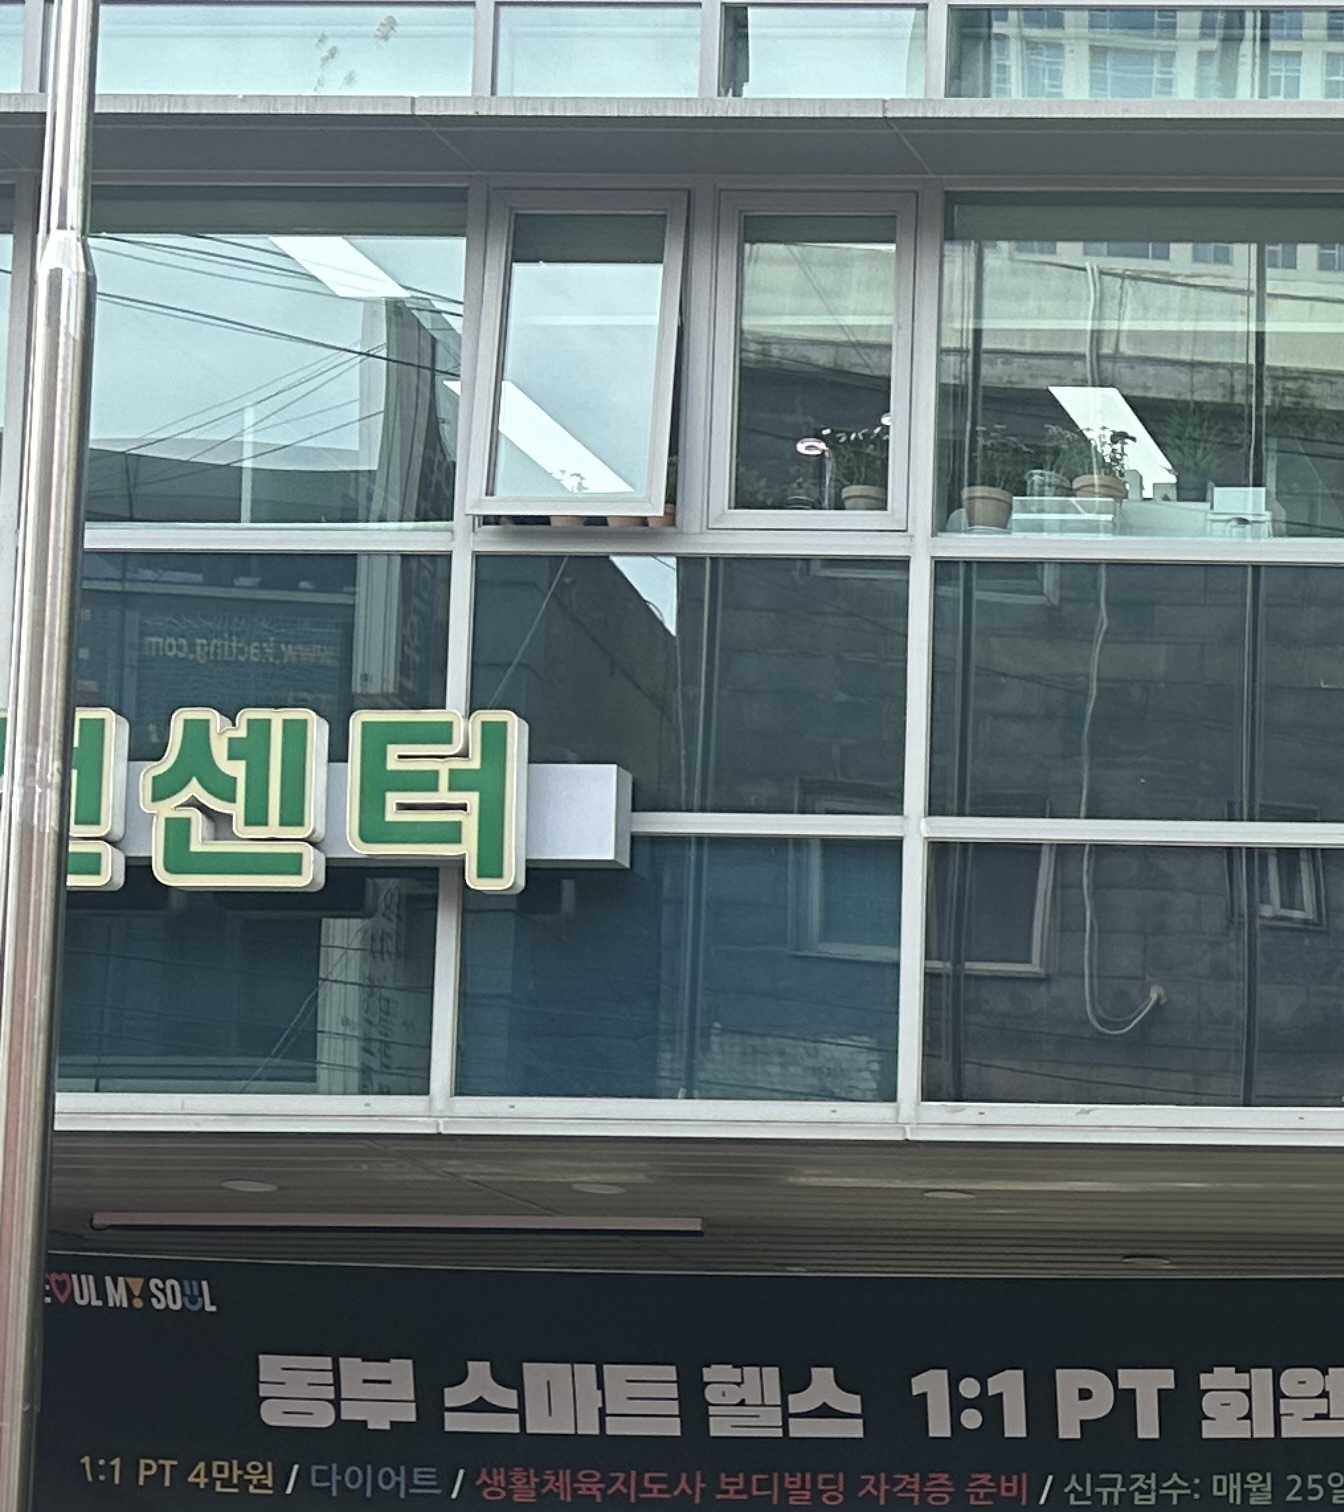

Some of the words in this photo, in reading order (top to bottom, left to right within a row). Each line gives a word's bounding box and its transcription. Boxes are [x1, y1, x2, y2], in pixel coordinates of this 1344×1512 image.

[259, 1355, 418, 1431] 동부
[444, 1361, 683, 1438] 스마트
[703, 1365, 865, 1440] 헬스
[912, 1370, 1028, 1439] 1:1
[1056, 1369, 1176, 1440] PT
[81, 1456, 122, 1486] 1:1
[138, 1459, 175, 1488] PT
[188, 1460, 275, 1496] 4만원
[311, 1464, 443, 1500] 다이어트
[477, 1468, 707, 1505] 생활체육지도사
[716, 1473, 845, 1507] 보디빌딩
[858, 1473, 956, 1507] 자격증
[966, 1474, 1028, 1507] 준비
[1064, 1473, 1201, 1507] 신규접수:
[1213, 1472, 1273, 1506] 매월
